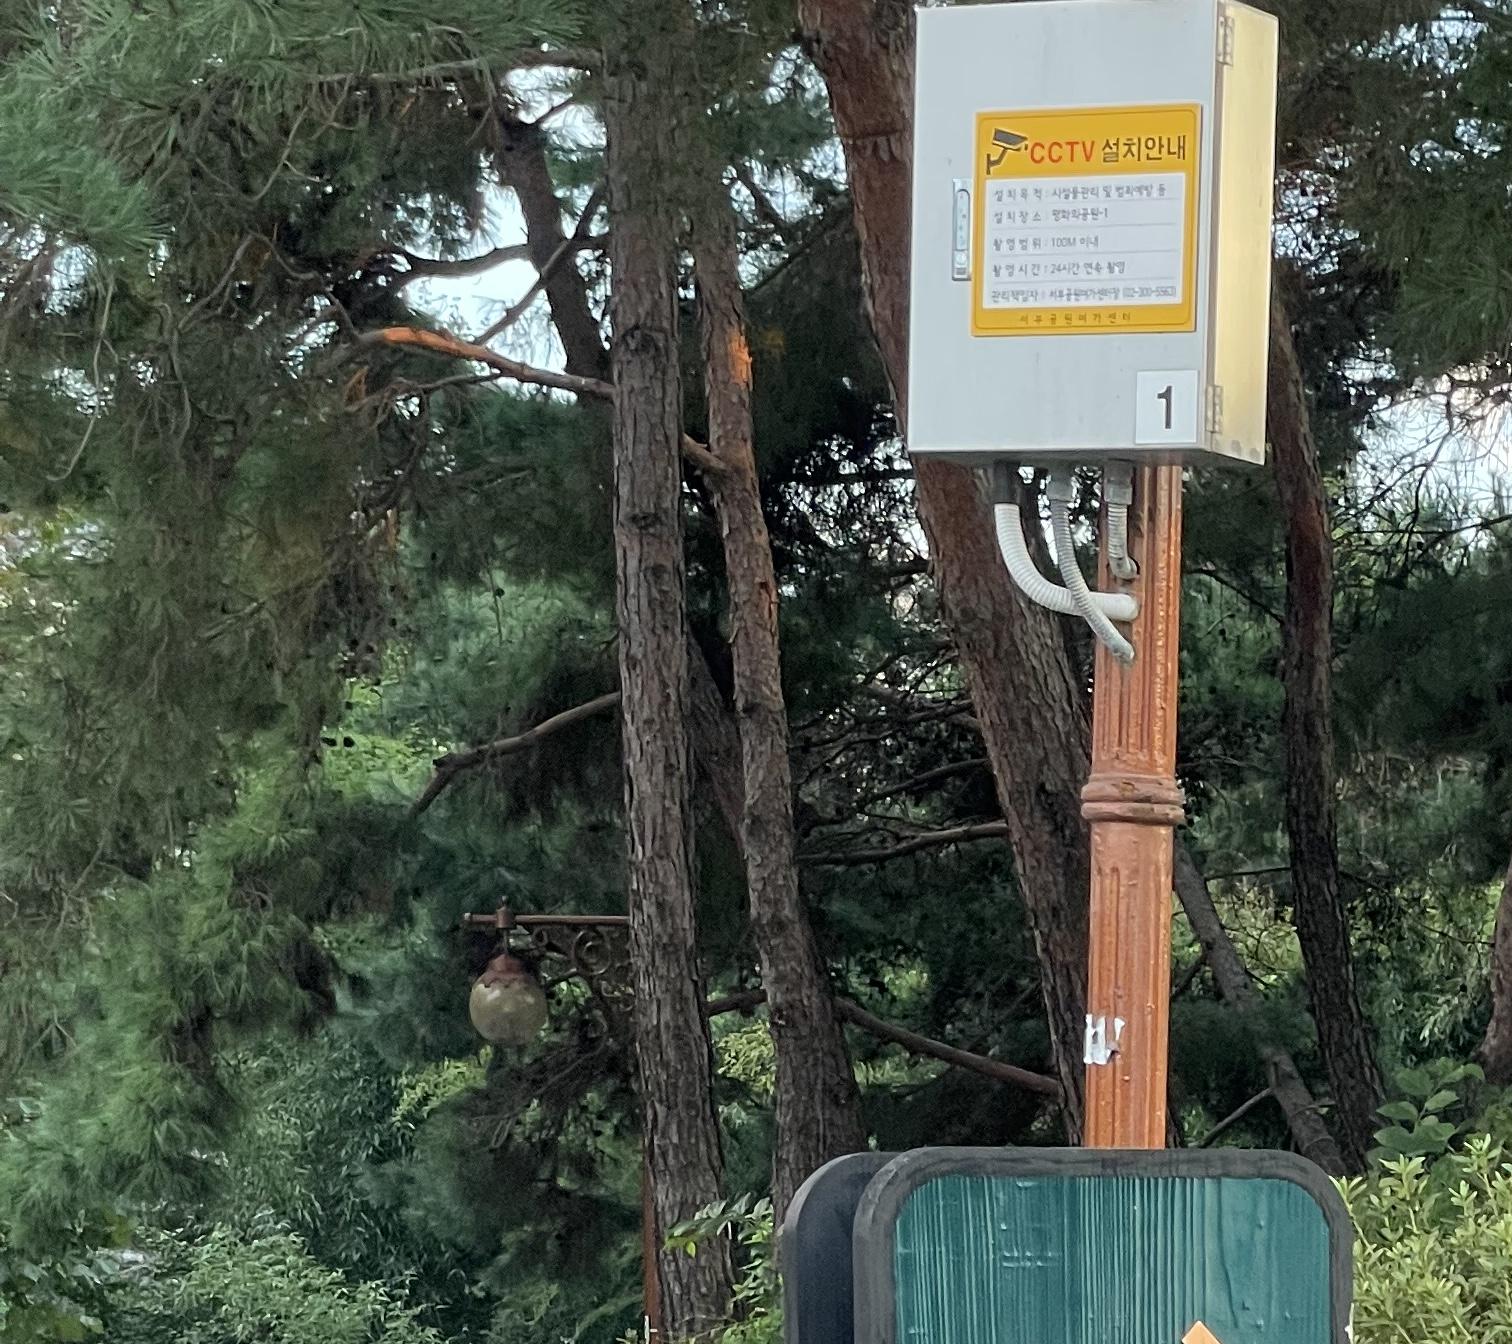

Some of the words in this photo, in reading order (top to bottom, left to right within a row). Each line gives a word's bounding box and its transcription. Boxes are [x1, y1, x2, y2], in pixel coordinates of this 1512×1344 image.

[1030, 140, 1096, 165] CCTV
[1101, 135, 1188, 163] 설치안내
[1156, 384, 1173, 430] 1
